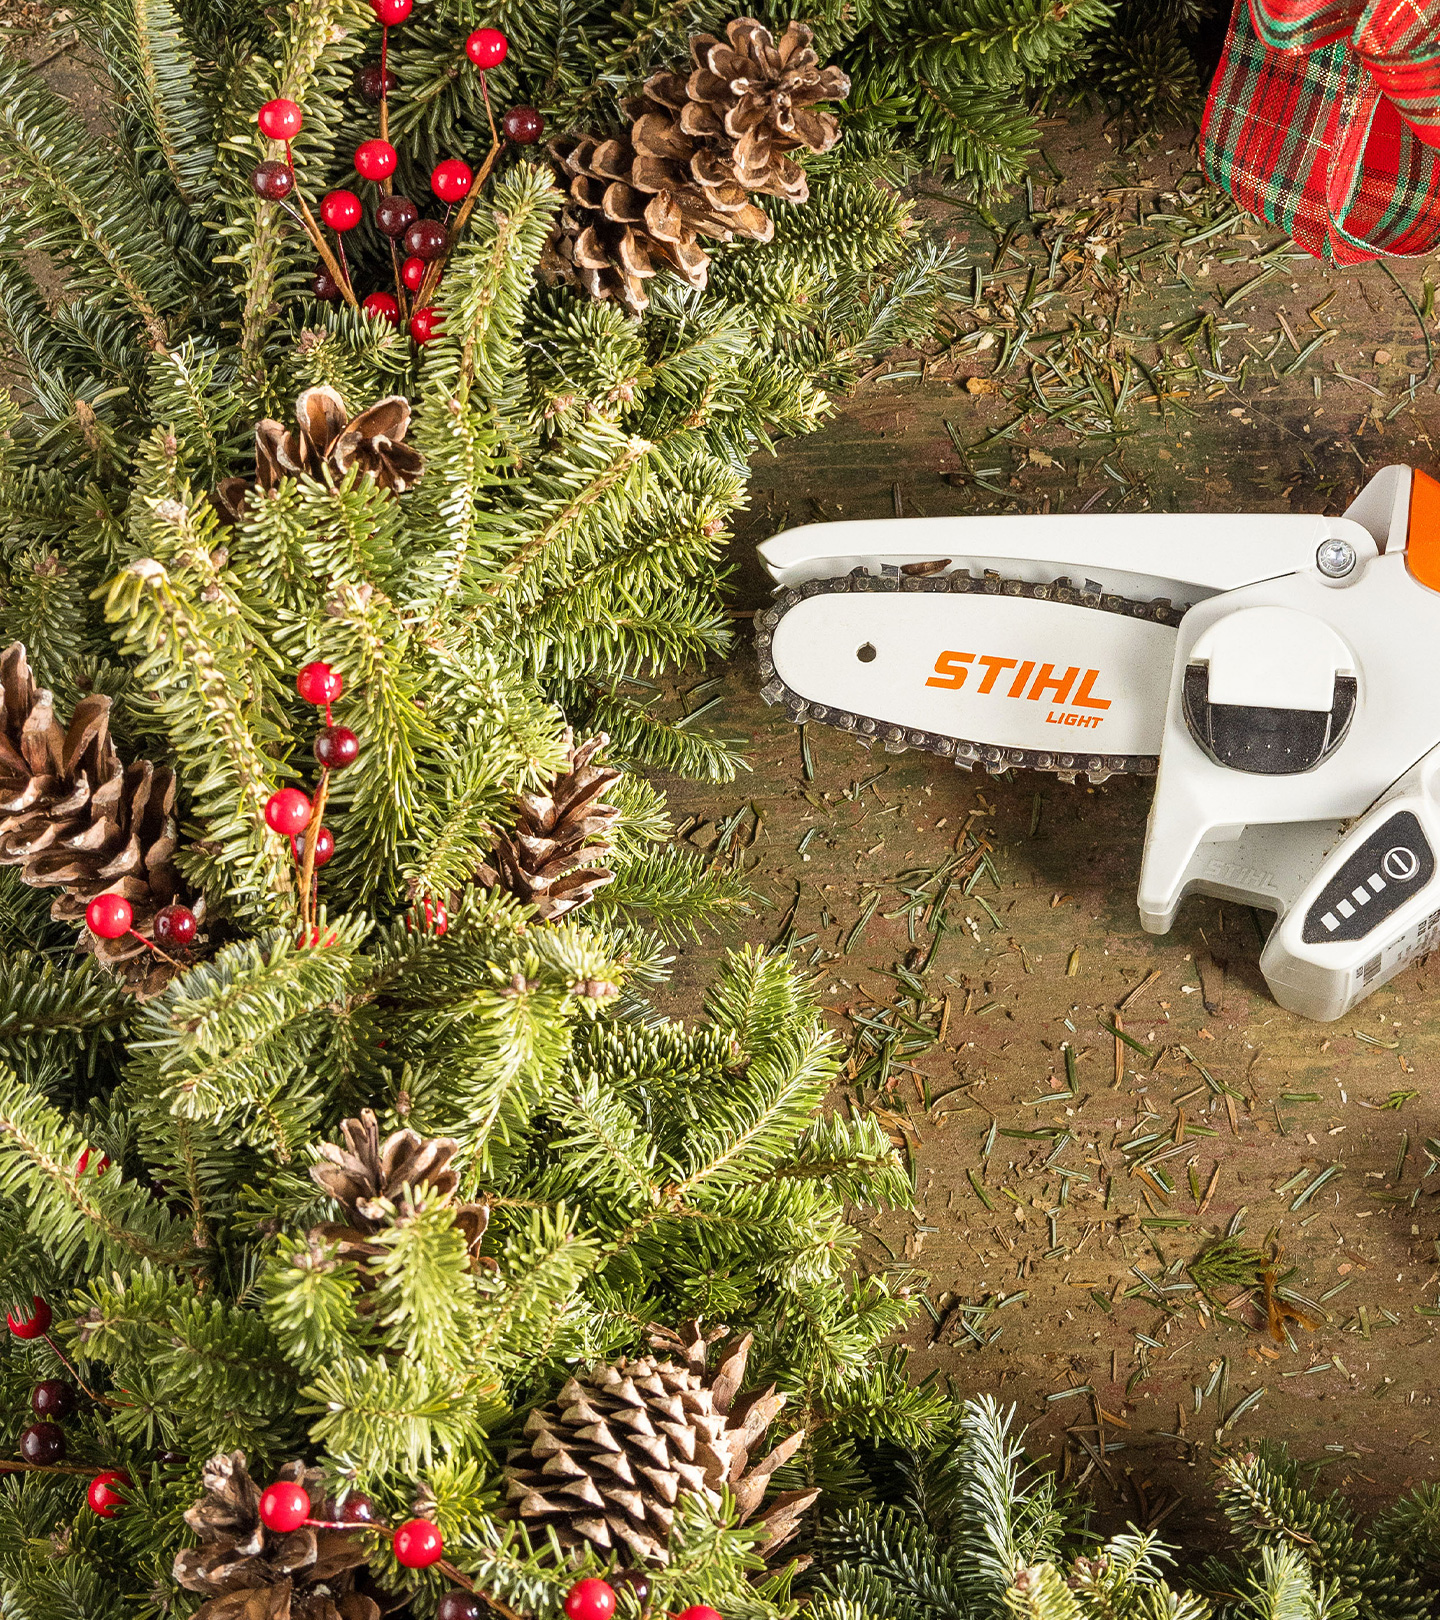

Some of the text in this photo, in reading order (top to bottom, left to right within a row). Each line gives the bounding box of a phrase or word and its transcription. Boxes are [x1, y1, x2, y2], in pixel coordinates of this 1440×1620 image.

[925, 650, 1112, 710] STIHL
[1045, 711, 1104, 729] LIGHT
[1204, 859, 1278, 891] STIHL
